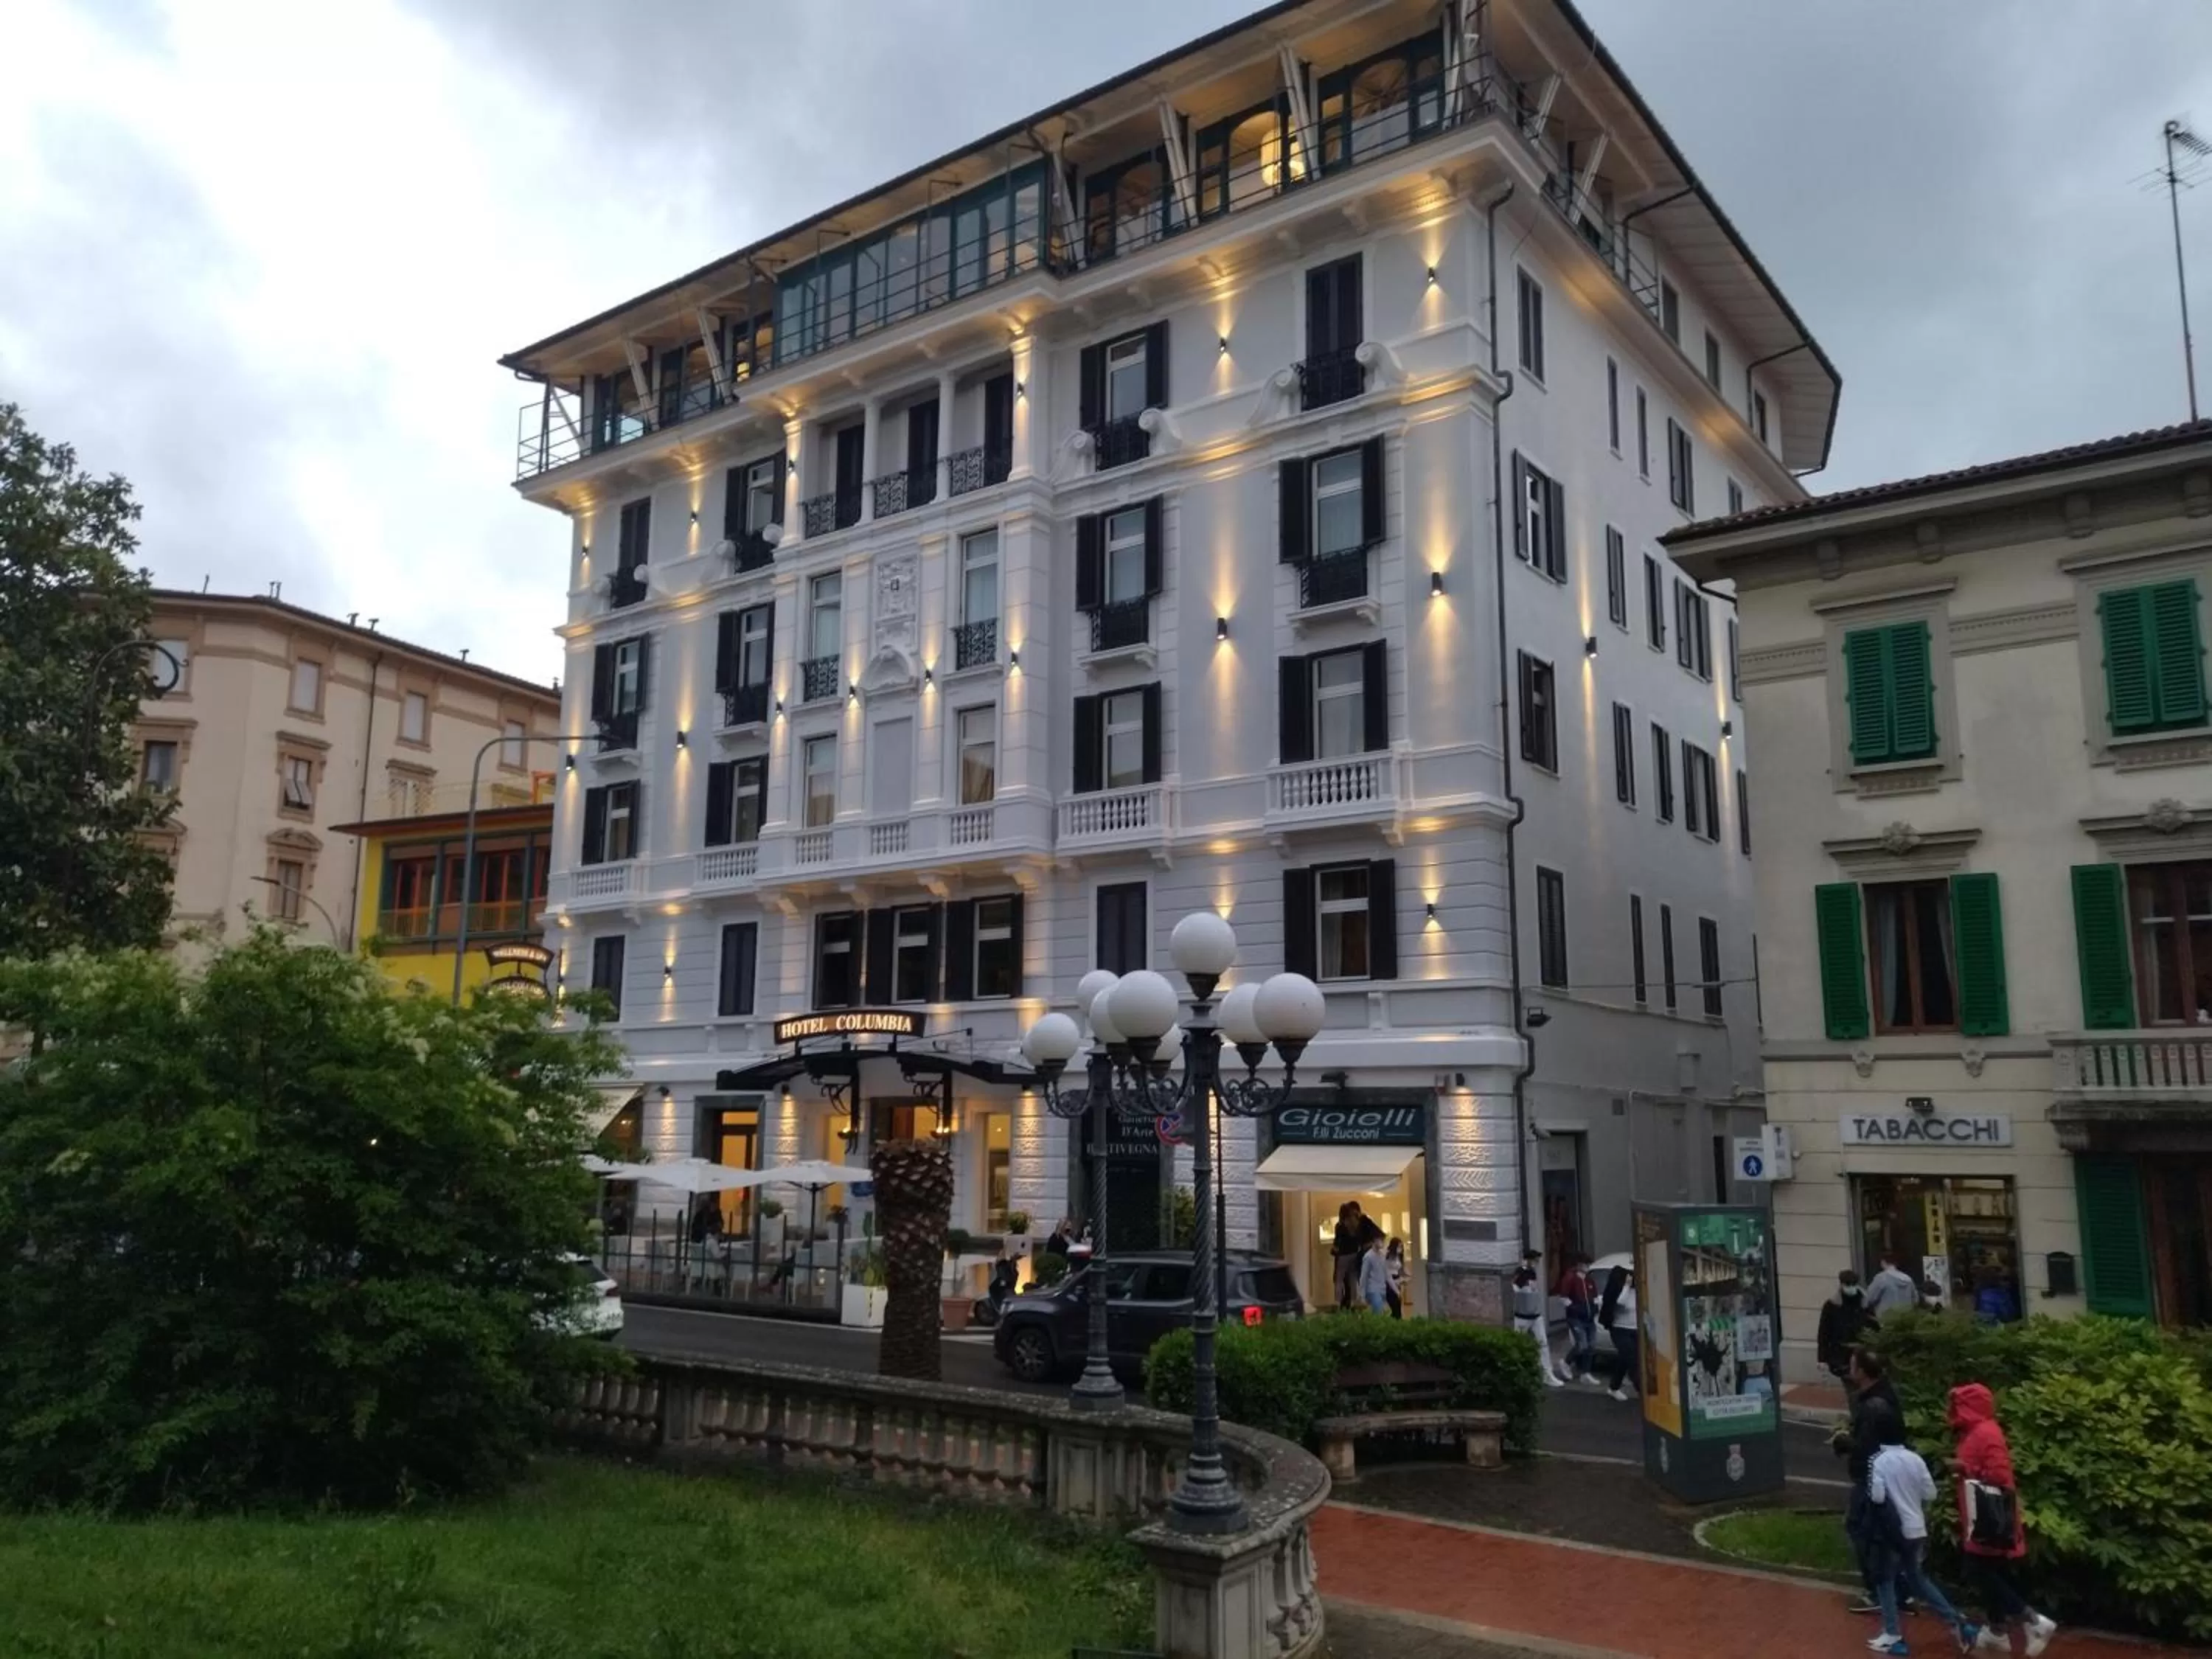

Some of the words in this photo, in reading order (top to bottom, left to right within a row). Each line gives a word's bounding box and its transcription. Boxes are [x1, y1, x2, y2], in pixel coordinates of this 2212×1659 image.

[780, 1017, 827, 1039] HOTEL
[835, 1014, 912, 1032] COLUMBIA
[1279, 1108, 1416, 1126] Gioielli
[1332, 1127, 1381, 1140] Zucconi
[1852, 1118, 2000, 1142] TABACCHI
